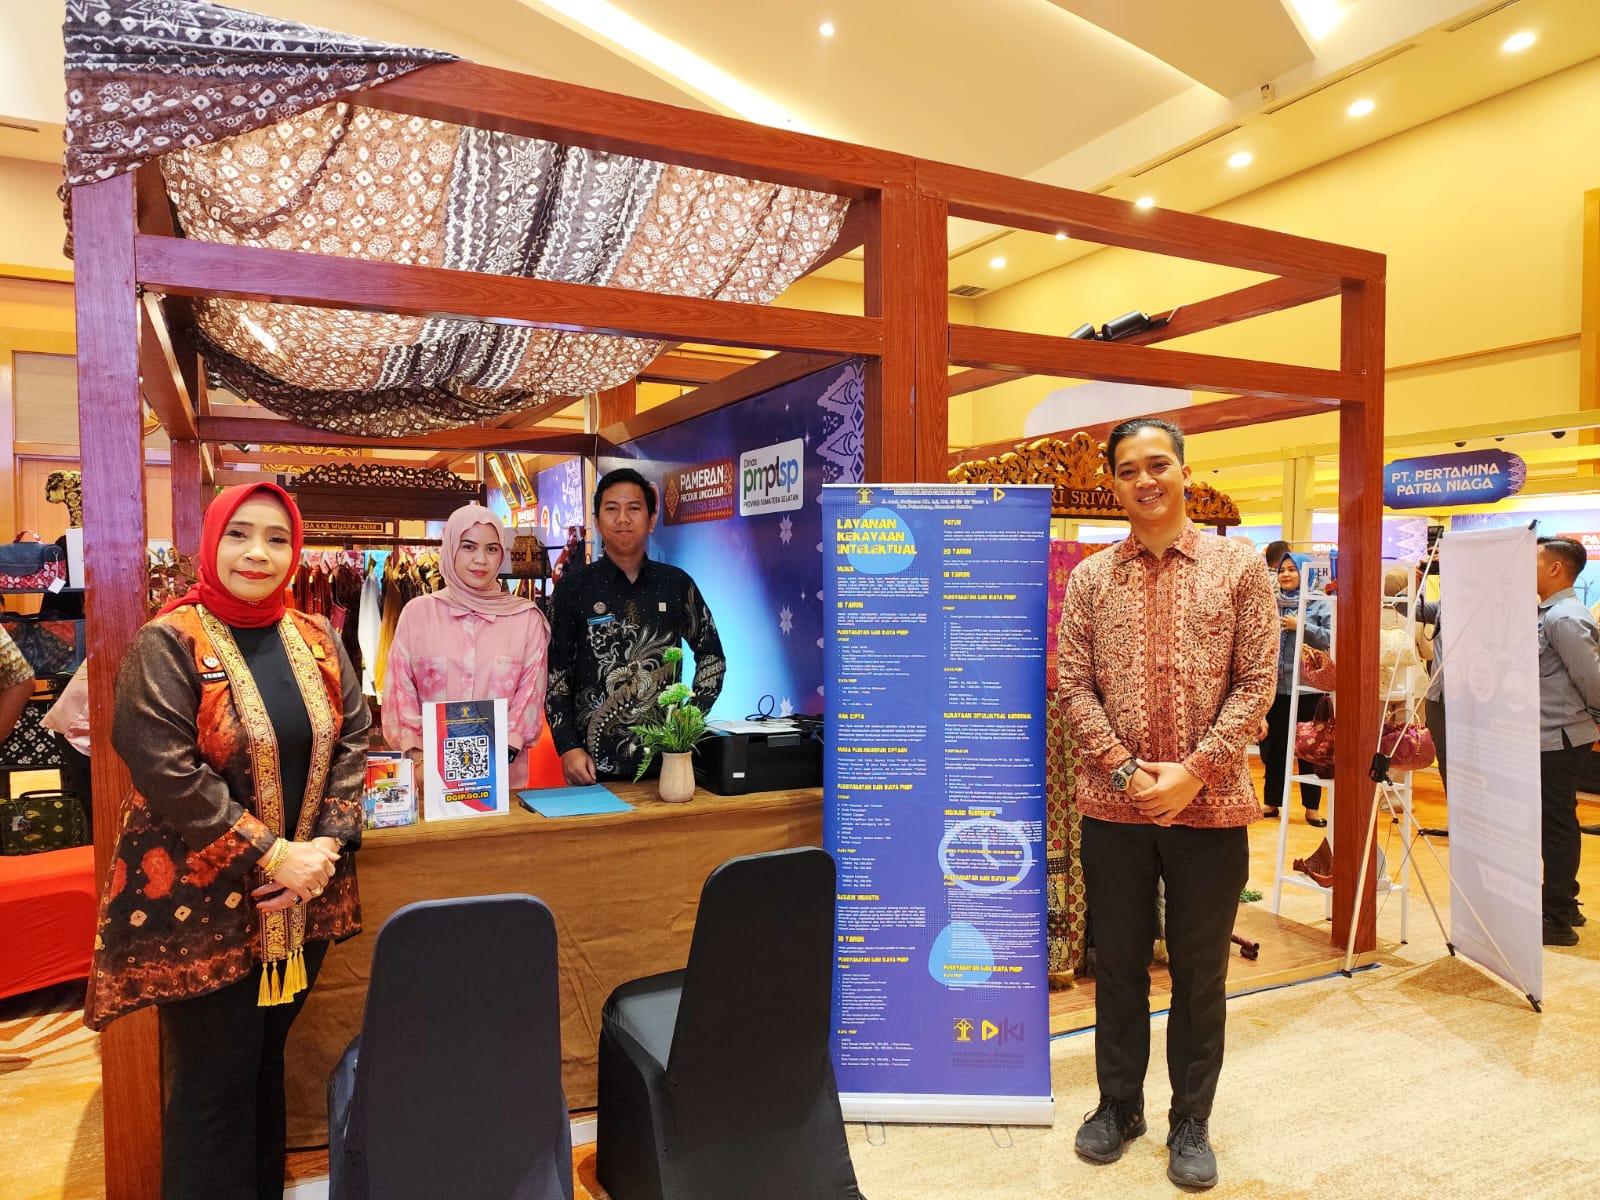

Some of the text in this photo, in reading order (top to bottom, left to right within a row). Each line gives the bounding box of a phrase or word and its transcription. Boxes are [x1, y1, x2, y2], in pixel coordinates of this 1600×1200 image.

[680, 464, 724, 491] PAMERAN
[1391, 462, 1500, 484] PT. PERTAMINA
[1396, 477, 1494, 496] PATRA NIAGA
[836, 518, 897, 529] LAYANAN
[836, 531, 905, 542] KEKAYAAN
[836, 543, 917, 555] INTELEKTUAL
[445, 791, 490, 802] DGIP.GO.ID
